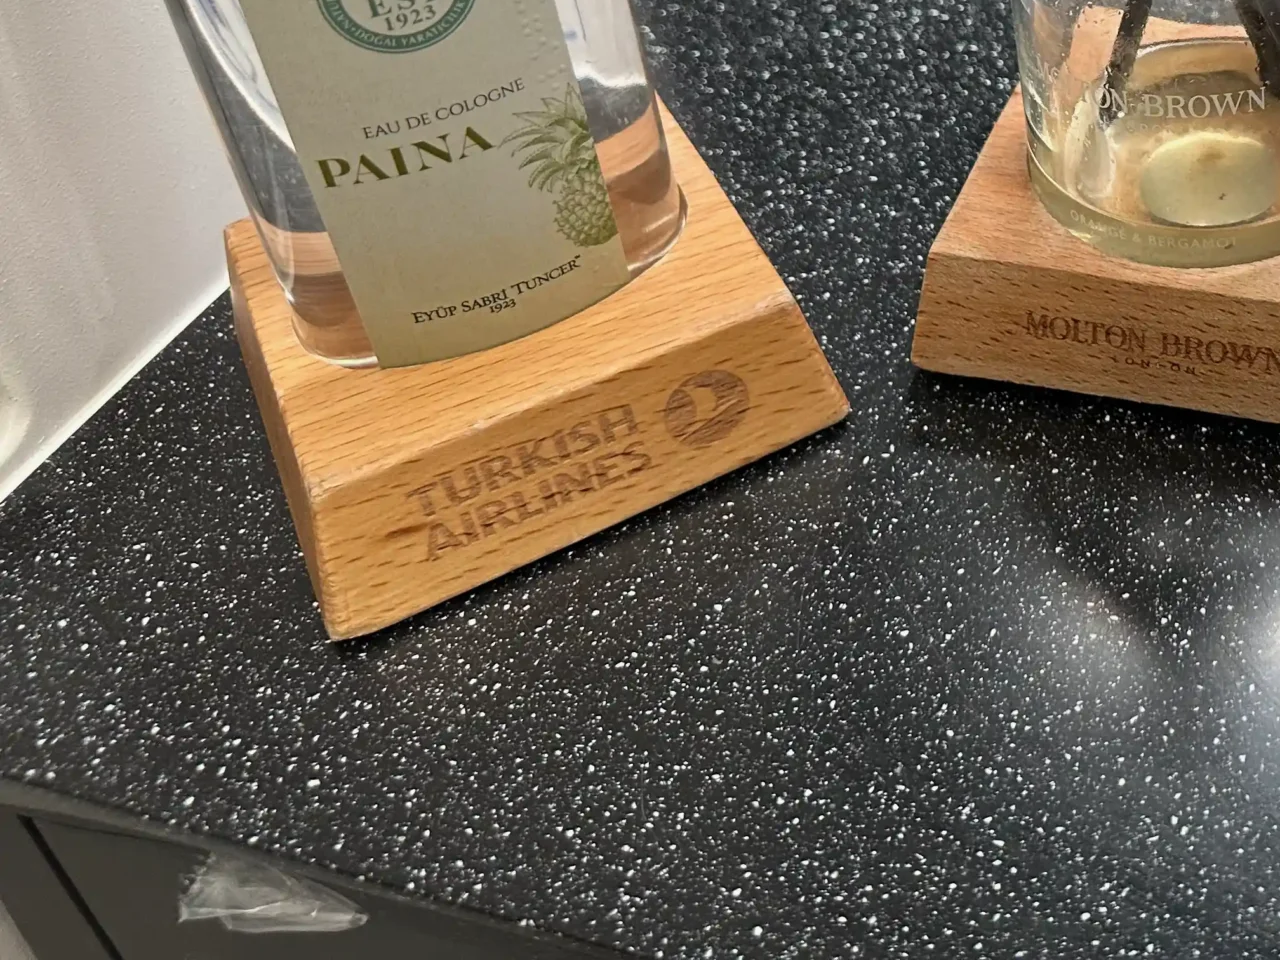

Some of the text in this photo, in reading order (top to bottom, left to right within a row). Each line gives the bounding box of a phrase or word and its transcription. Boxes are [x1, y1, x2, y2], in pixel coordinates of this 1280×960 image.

[384, 4, 437, 31] 1923
[361, 77, 525, 139] EAU DE COLOGNE
[1143, 87, 1266, 120] BROWN
[315, 126, 497, 189] PAINA
[1149, 234, 1236, 250] BERGAMOT
[411, 306, 457, 324] EYÜP
[490, 298, 517, 314] 1923
[1025, 310, 1148, 353] MOLTON
[406, 403, 639, 517] TURKISH
[427, 440, 652, 562] AIRLINES
